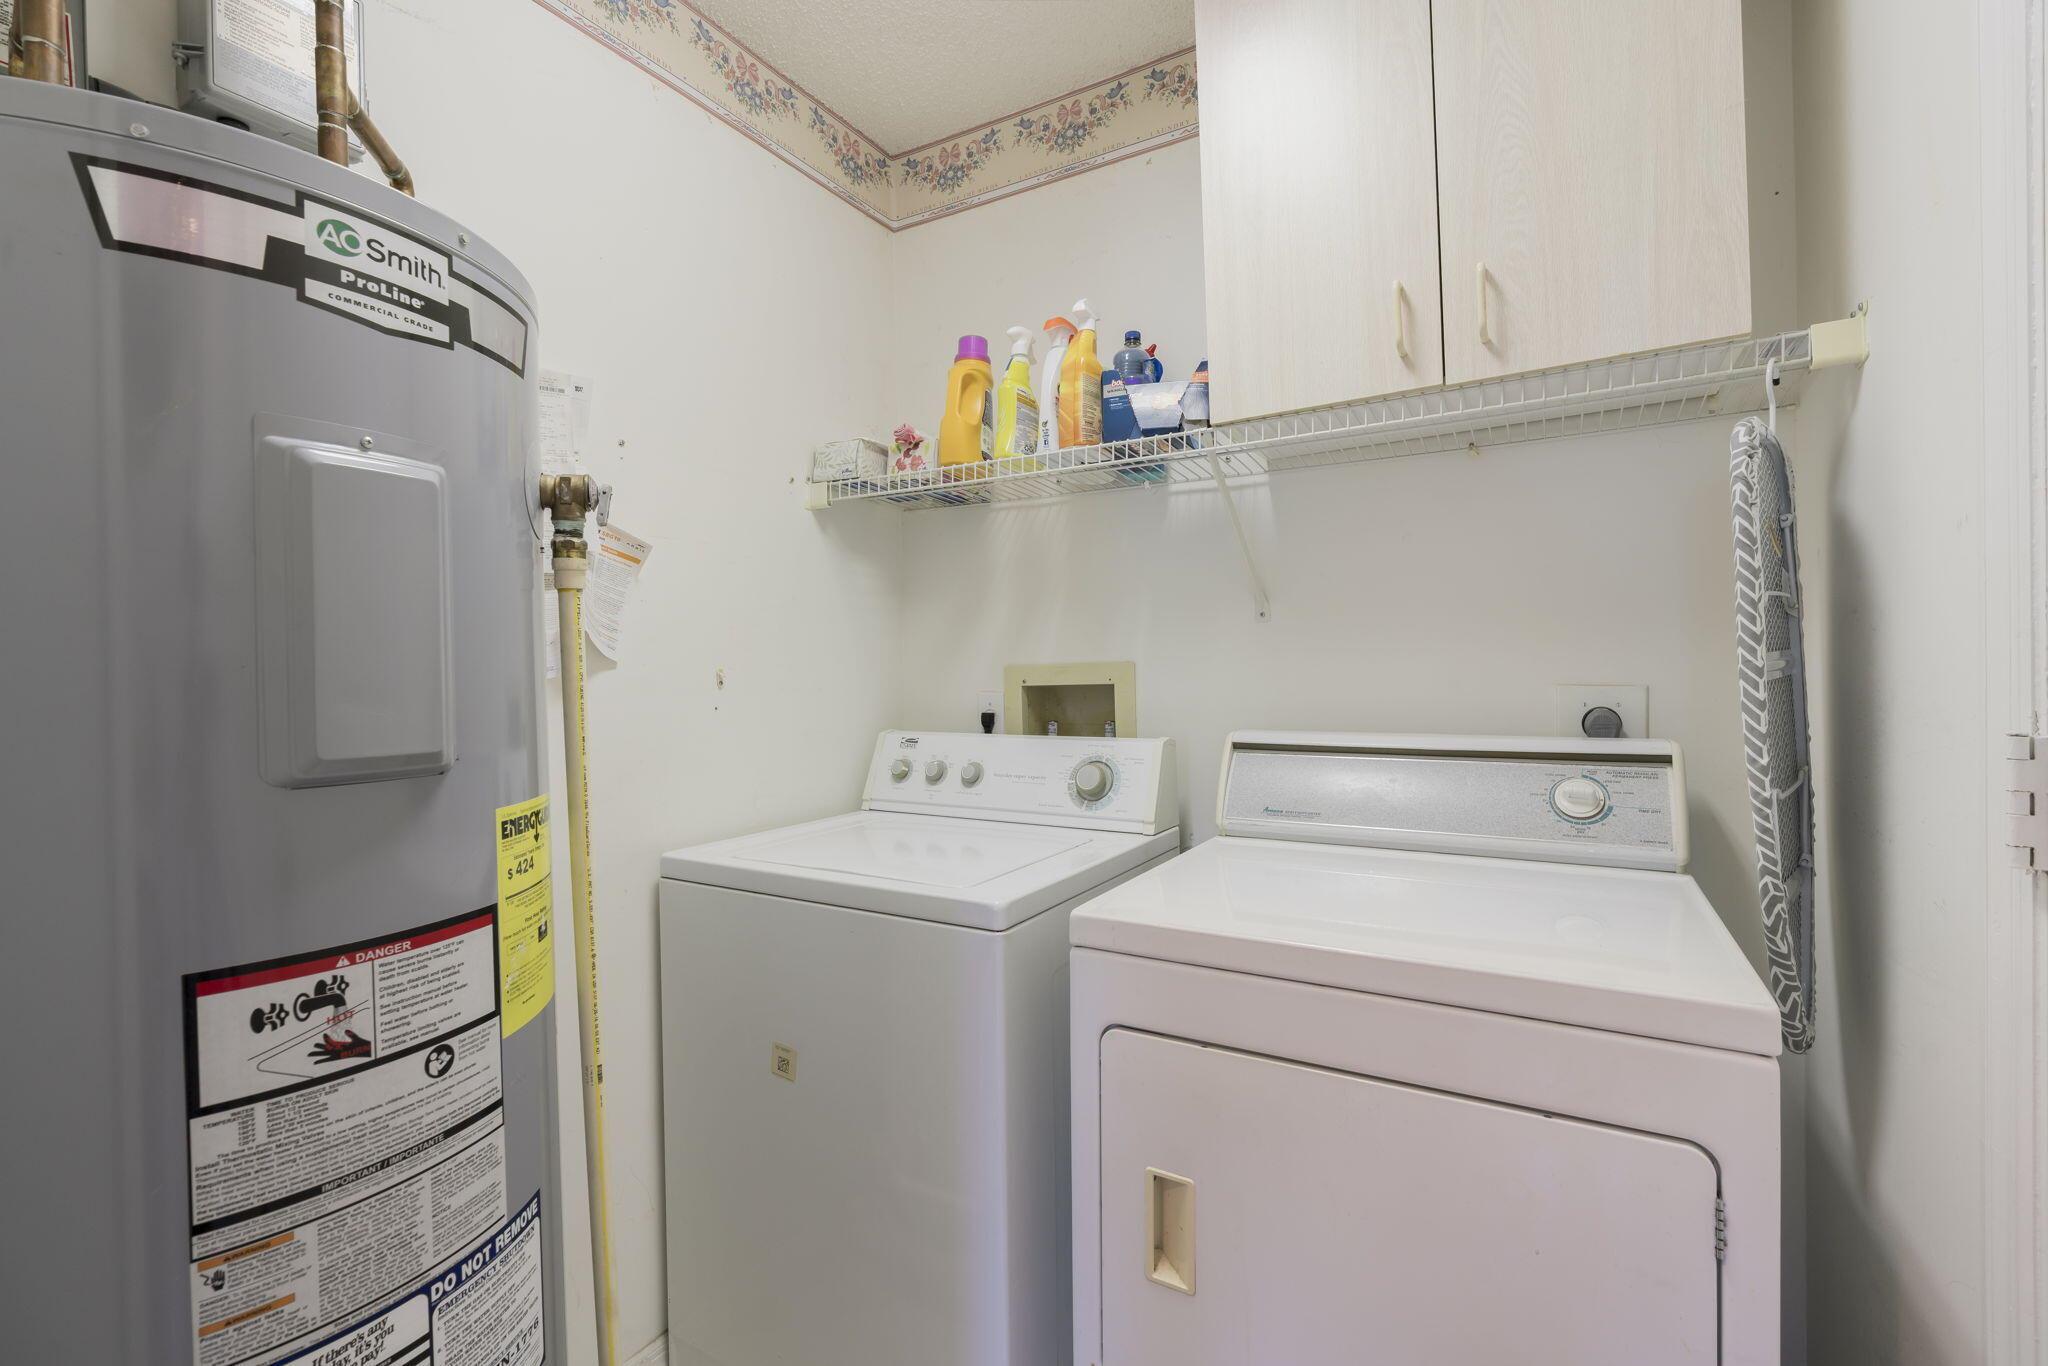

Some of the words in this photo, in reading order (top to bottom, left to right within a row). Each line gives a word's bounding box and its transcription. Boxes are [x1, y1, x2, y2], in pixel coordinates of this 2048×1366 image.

[366, 237, 443, 289] Smith
[340, 269, 424, 309] ProLine
[328, 292, 400, 320] COMMERCIAL
[403, 316, 434, 332] GRADE
[515, 855, 535, 876] 424
[355, 941, 412, 963] DANGER
[321, 1165, 382, 1193] IMPORTANT
[389, 1133, 446, 1165] IMPORTANTE
[431, 1272, 457, 1302] DO
[461, 1244, 493, 1280] NOT
[495, 1198, 539, 1254] REMOVE
[438, 1264, 497, 1315] EMERGENCY
[324, 1330, 365, 1360] there's
[367, 1316, 389, 1340] any
[374, 1324, 395, 1350] you
